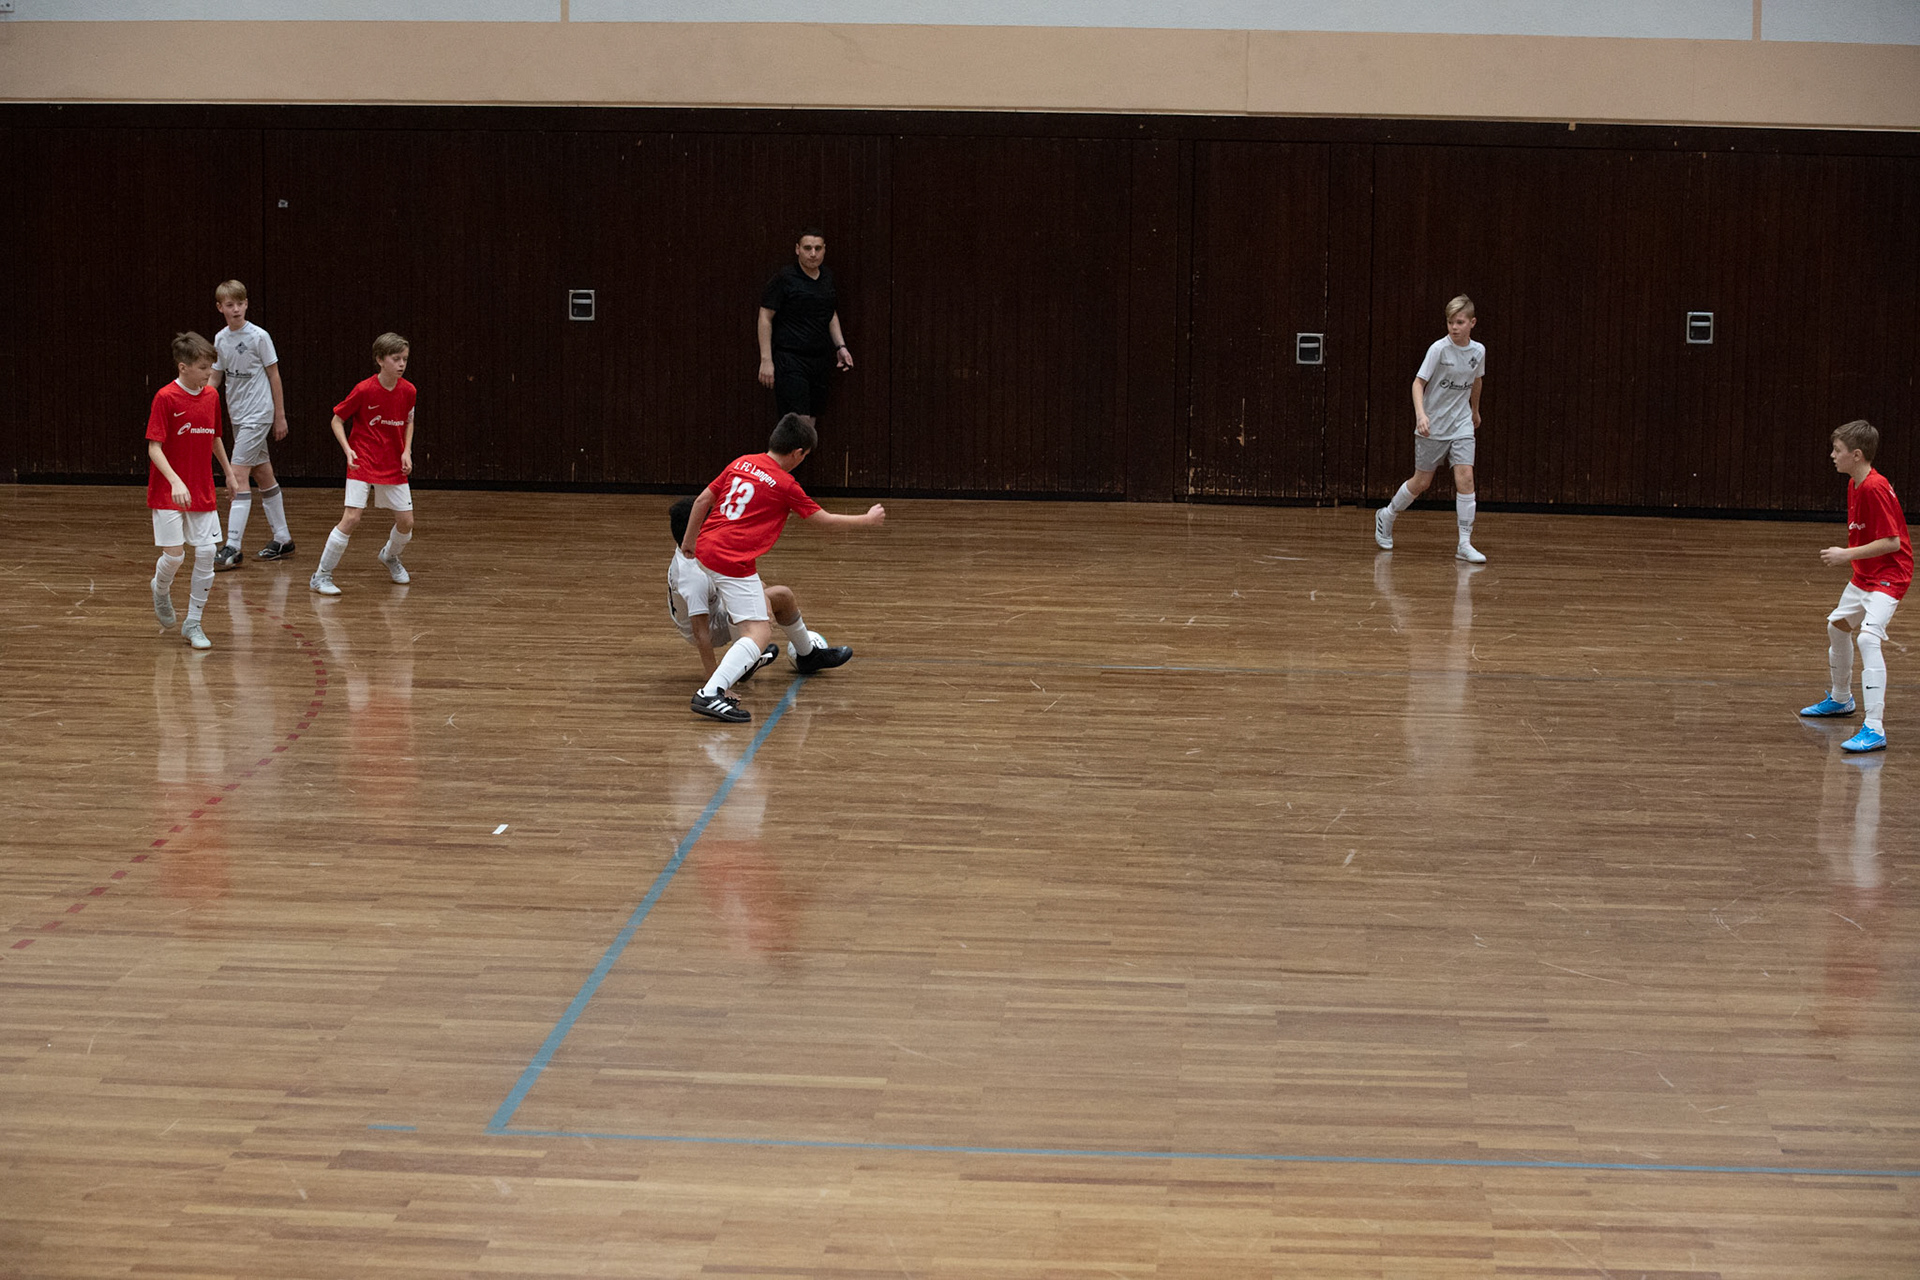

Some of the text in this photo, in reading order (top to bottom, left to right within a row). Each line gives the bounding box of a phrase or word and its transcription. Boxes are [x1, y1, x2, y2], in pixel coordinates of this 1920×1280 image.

[733, 461, 777, 488] 1. FC Langen
[720, 476, 755, 520] 13
